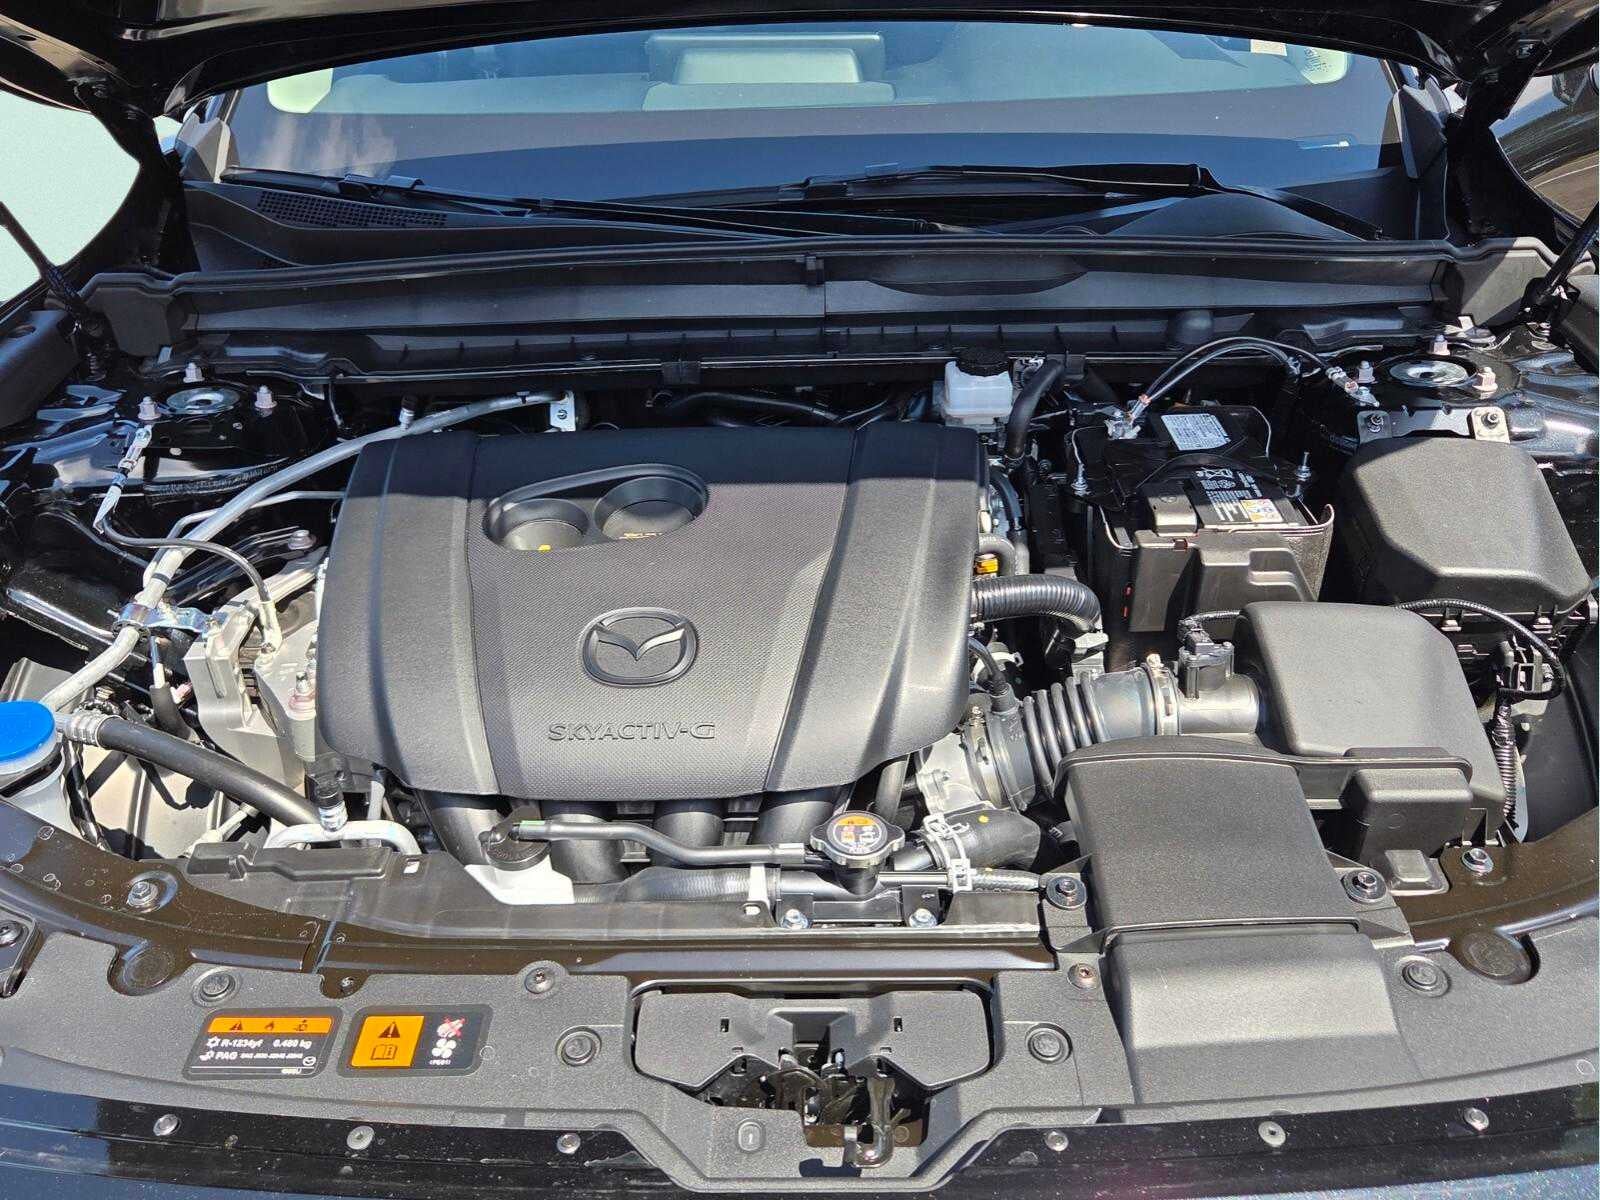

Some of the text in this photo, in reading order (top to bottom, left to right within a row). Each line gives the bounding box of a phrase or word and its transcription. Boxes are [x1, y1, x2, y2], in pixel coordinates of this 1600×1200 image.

[548, 722, 716, 741] SKYACTIV-G
[220, 1038, 264, 1049] R-1234yf
[299, 1038, 313, 1050] kg
[215, 1051, 239, 1060] PAG
